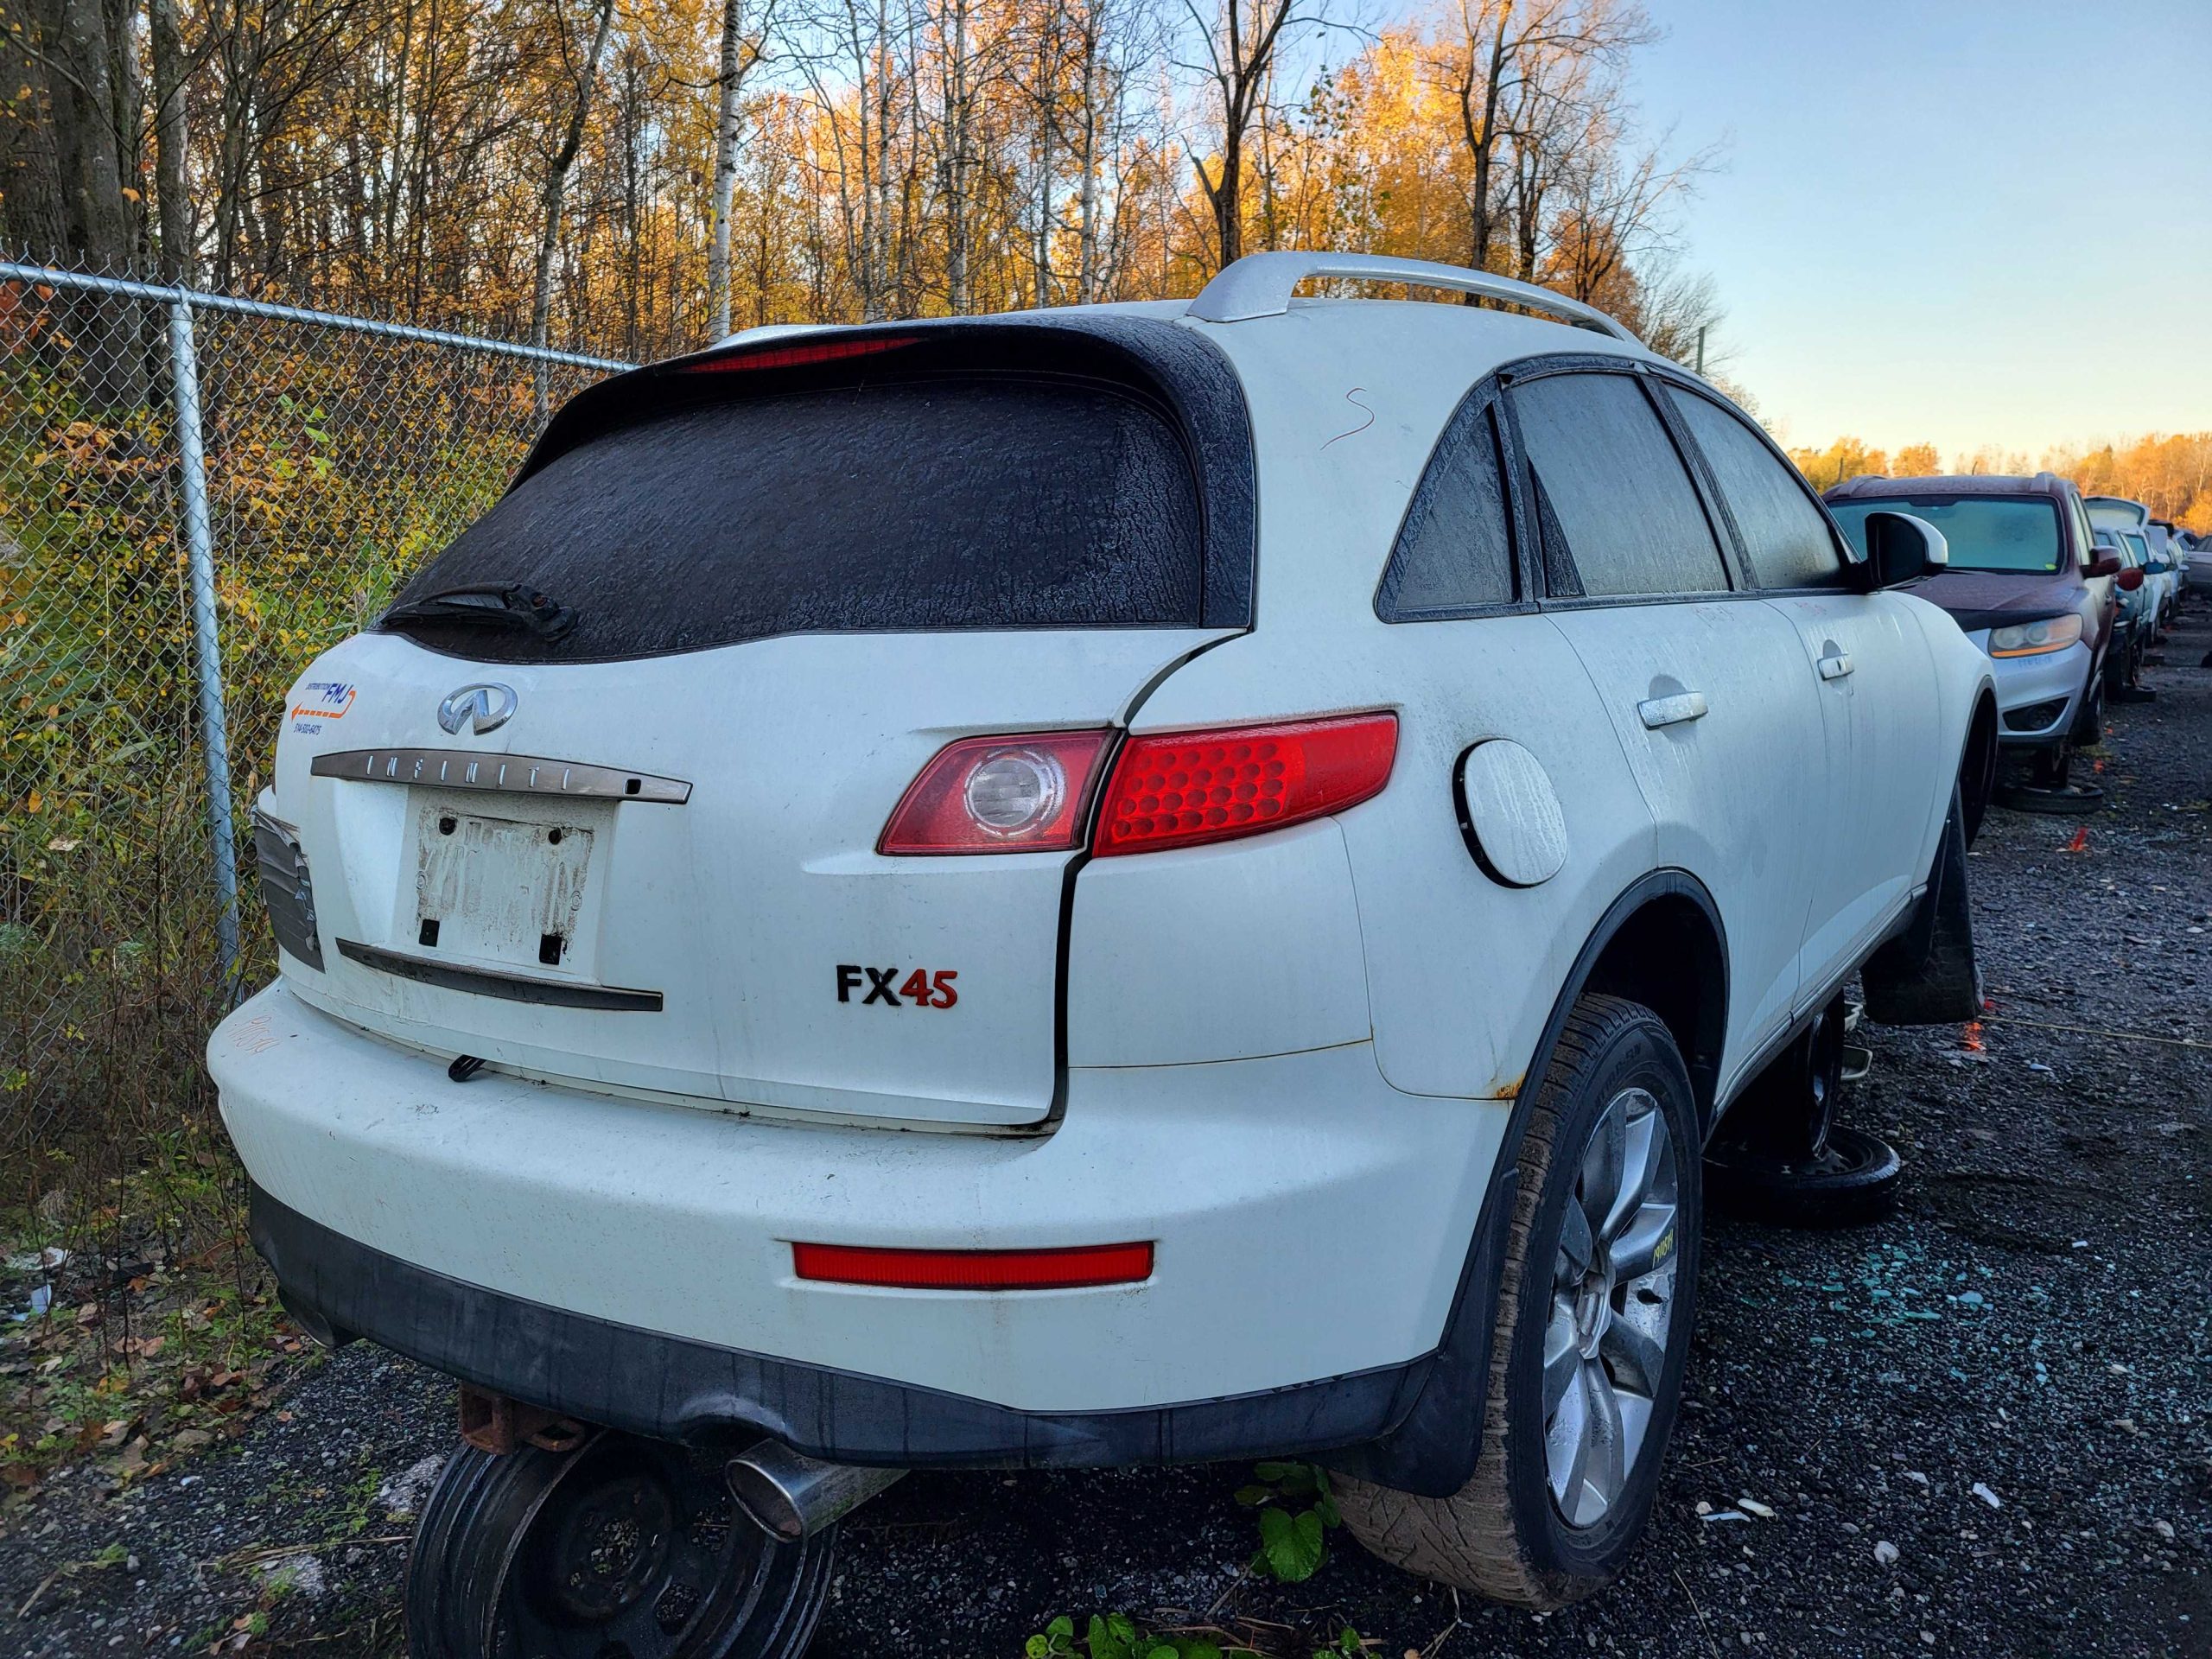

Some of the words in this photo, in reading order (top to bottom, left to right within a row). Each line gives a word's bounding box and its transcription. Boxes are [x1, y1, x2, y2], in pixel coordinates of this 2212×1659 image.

[321, 683, 354, 703] FMJ
[366, 754, 570, 791] INFINITI
[836, 964, 958, 1009] FX45
